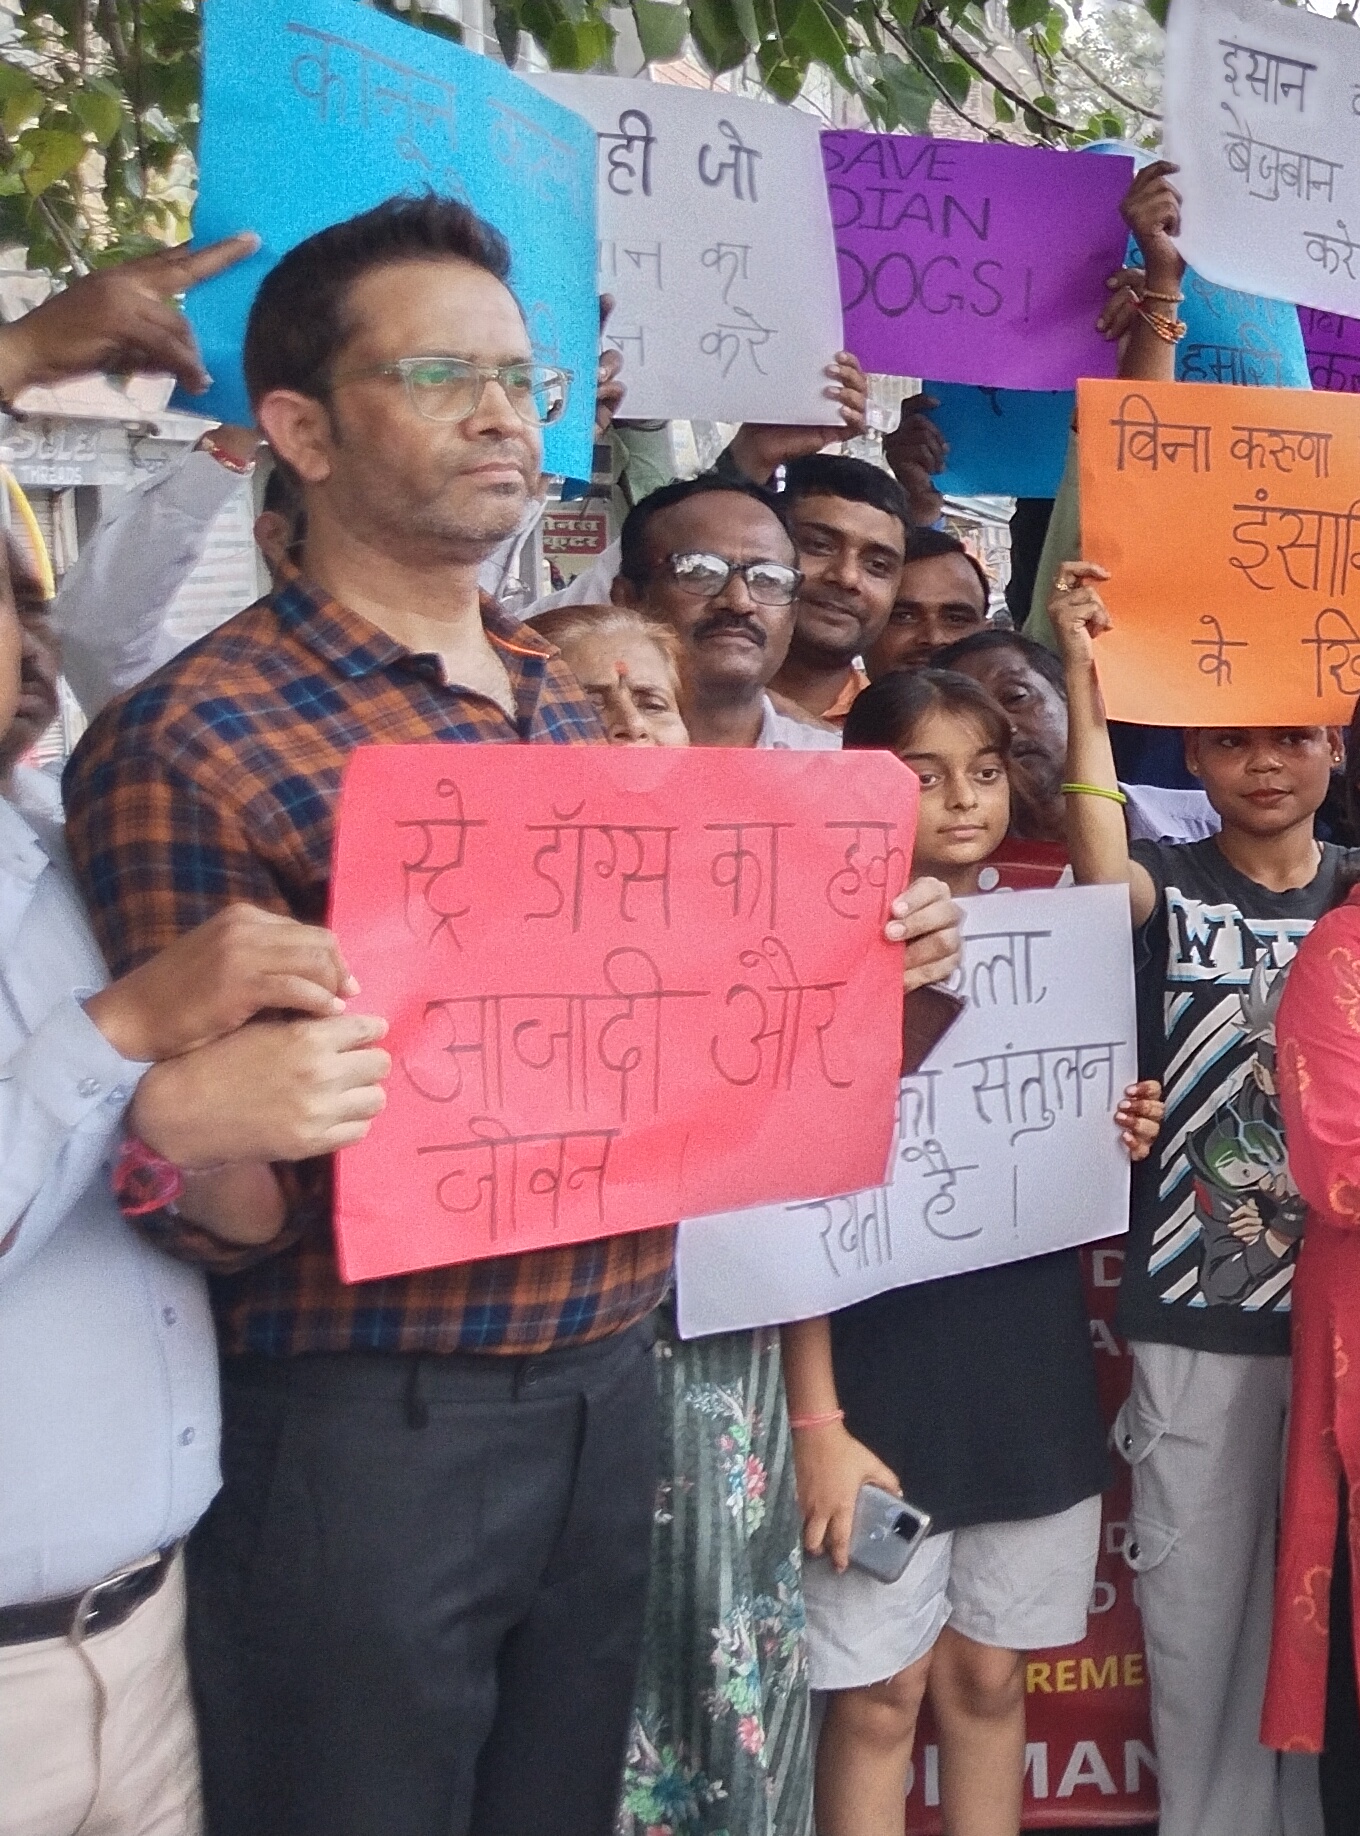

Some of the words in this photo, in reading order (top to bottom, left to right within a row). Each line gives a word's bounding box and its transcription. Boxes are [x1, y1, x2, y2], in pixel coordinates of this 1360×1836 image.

[597, 109, 657, 197] ही
[699, 119, 763, 203] जो
[831, 184, 992, 240] DIAN
[701, 242, 752, 305] का
[1112, 394, 1211, 472] बिना
[1191, 615, 1248, 687] के
[705, 822, 796, 929] का
[712, 937, 853, 1090] और
[1026, 1652, 1146, 1694] REME
